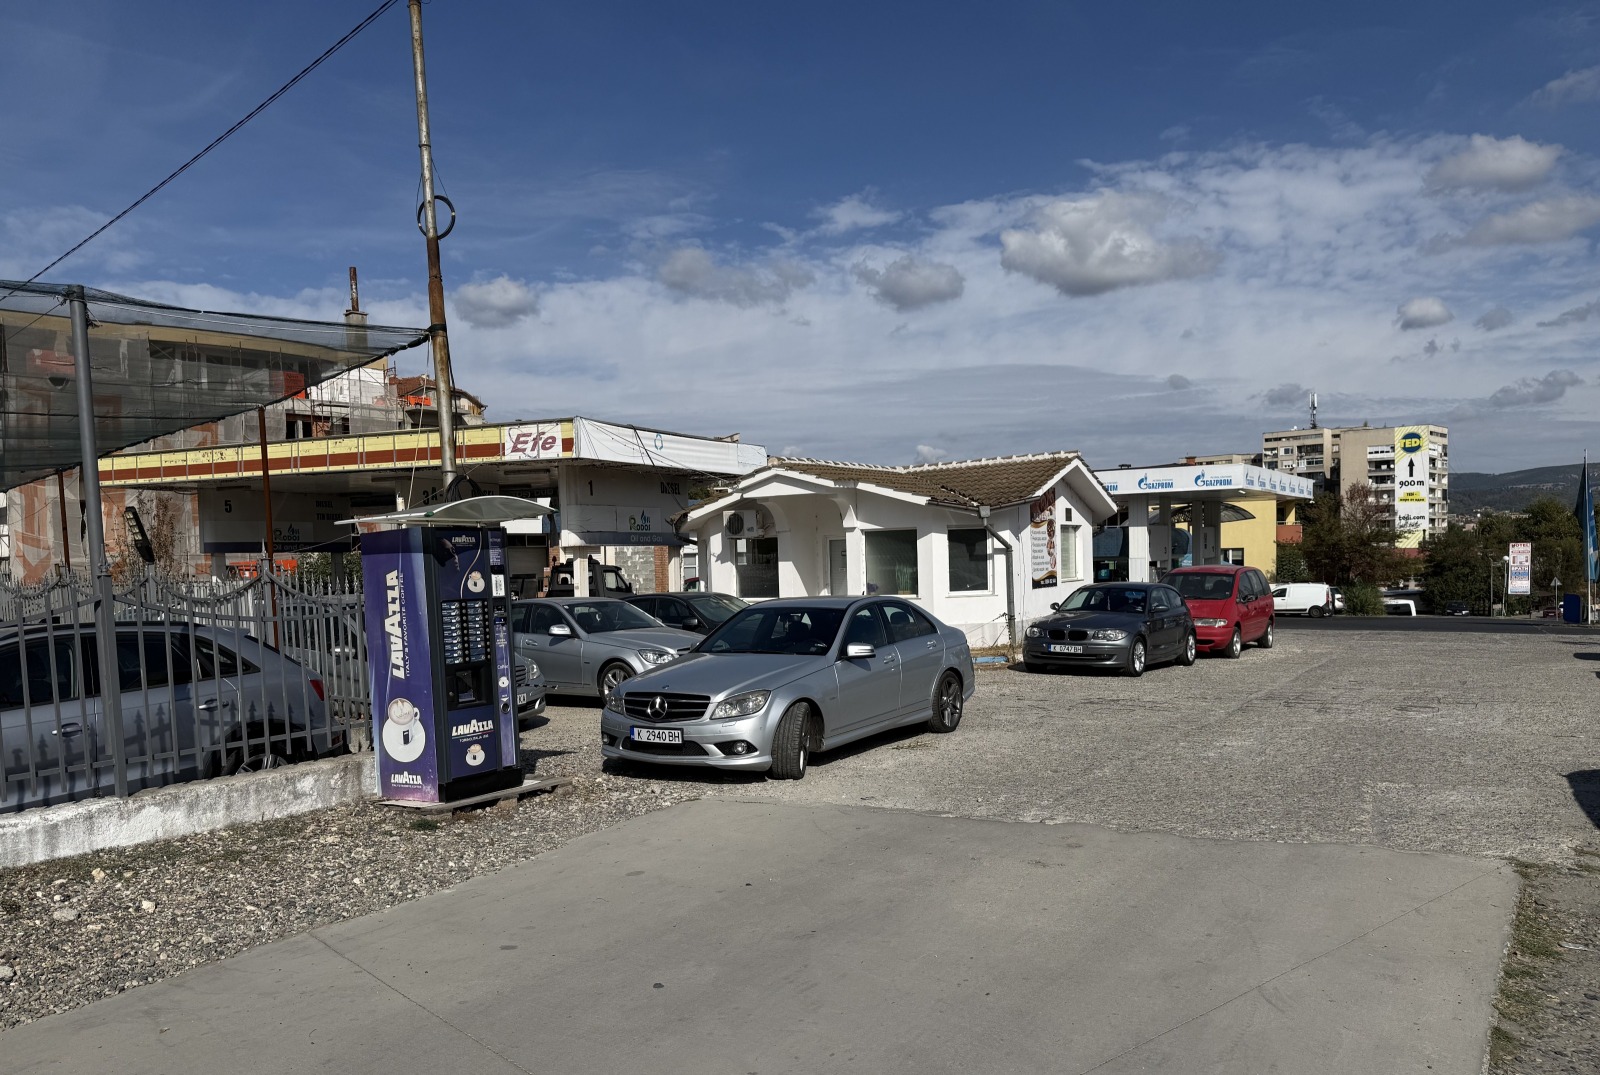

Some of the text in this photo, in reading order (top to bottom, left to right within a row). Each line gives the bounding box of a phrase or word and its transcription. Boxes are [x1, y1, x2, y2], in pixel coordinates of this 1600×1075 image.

[511, 432, 557, 453] Efe
[588, 480, 593, 496] 1
[661, 482, 680, 494] DIESEL
[1206, 479, 1232, 487] GAZPROM
[1399, 480, 1415, 488] 900
[224, 500, 232, 513] 5
[385, 569, 405, 679] LAVAZZA
[452, 719, 494, 736] LAVAZZA
[637, 729, 680, 742] K 2940 BH
[391, 771, 422, 785] LAVAZZA
